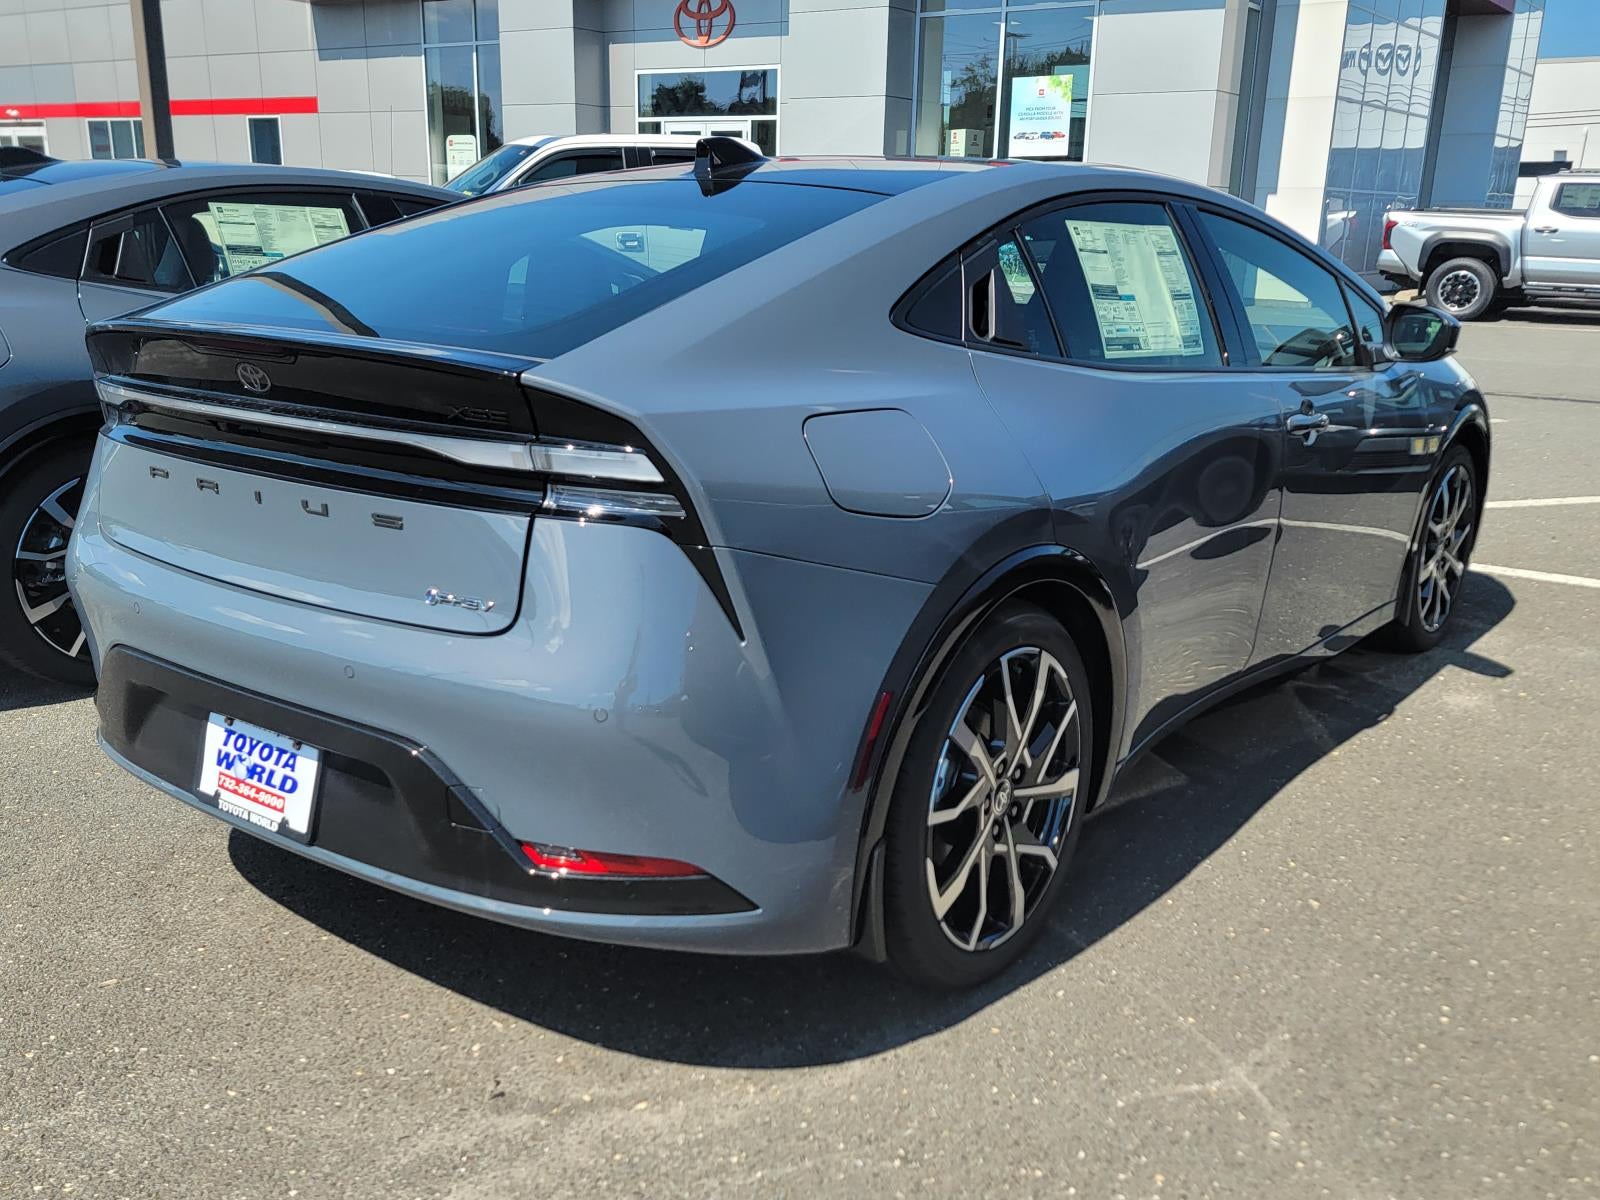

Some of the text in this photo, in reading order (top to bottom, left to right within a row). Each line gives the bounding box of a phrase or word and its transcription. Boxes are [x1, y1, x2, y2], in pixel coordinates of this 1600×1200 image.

[447, 406, 511, 425] XSE
[148, 465, 405, 531] PRIUS
[222, 727, 298, 772] TOYOTA
[216, 748, 299, 794] WORLD
[218, 774, 284, 809] 732-364-9000
[218, 799, 279, 832] TOYOTA WORLD
